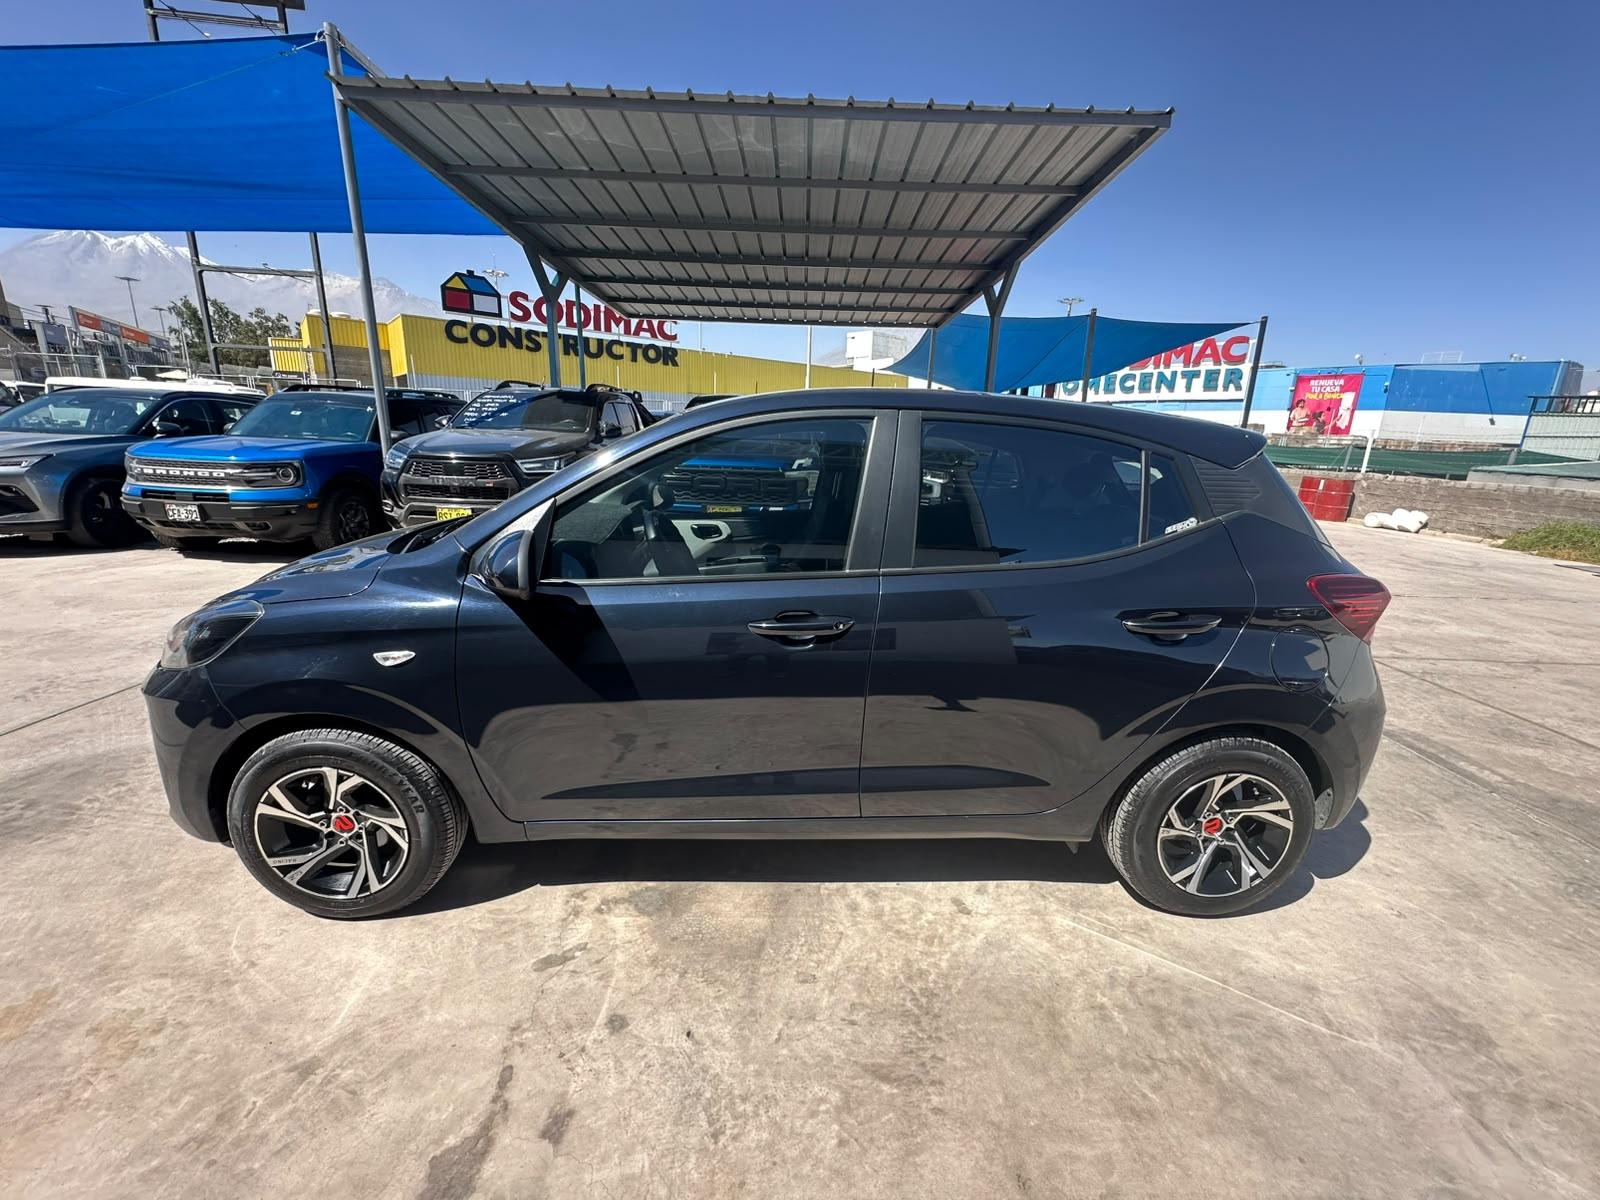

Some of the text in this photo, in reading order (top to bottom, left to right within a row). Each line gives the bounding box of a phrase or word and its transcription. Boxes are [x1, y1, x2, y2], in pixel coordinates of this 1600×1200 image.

[509, 291, 678, 342] SODIMAC
[1062, 368, 1243, 396] OMECENTER
[1321, 385, 1341, 393] CASA
[143, 468, 225, 477] BRONCO
